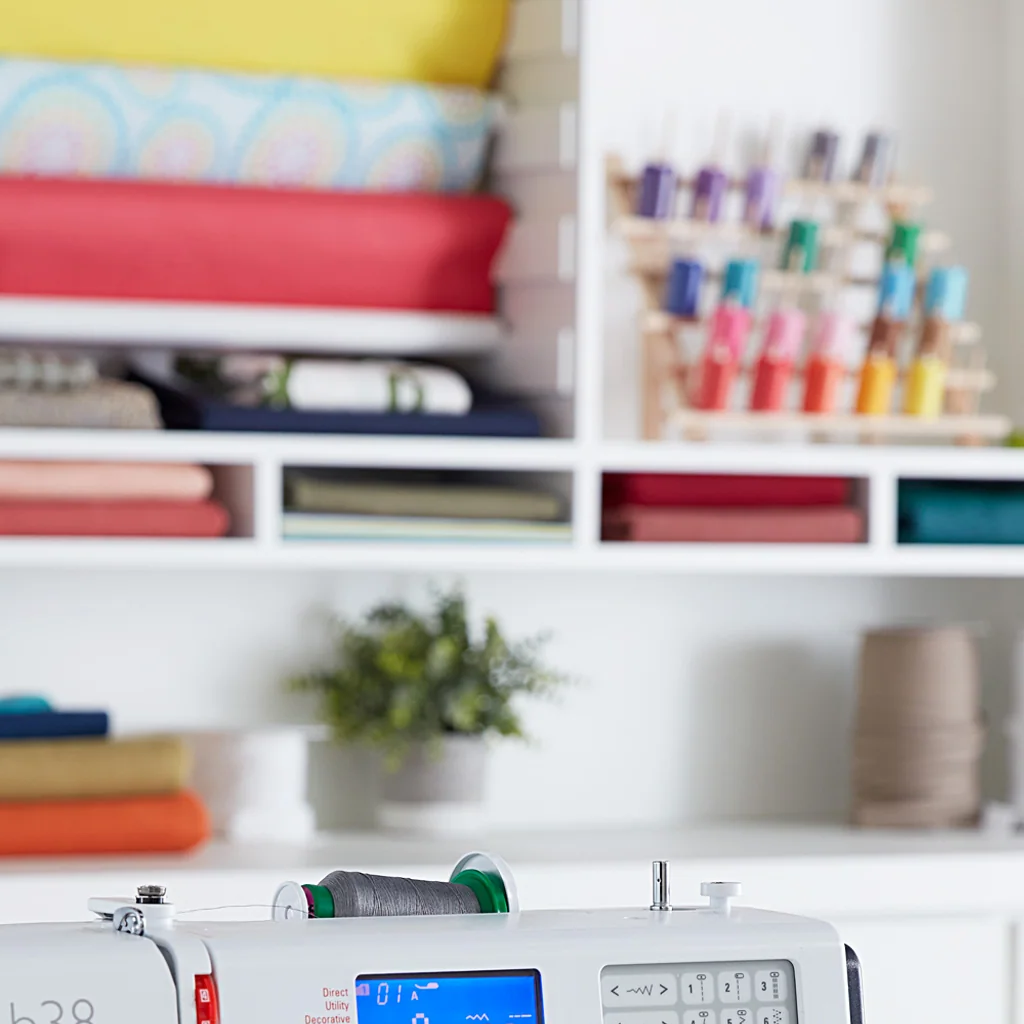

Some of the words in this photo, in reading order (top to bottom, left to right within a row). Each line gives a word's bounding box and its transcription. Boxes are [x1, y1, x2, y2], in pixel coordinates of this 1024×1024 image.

[688, 984, 694, 994] 1
[724, 982, 731, 993] 2
[761, 981, 767, 992] 3
[322, 987, 349, 998] Direct
[325, 1000, 350, 1012] Utility
[304, 1013, 351, 1024] Decorative
